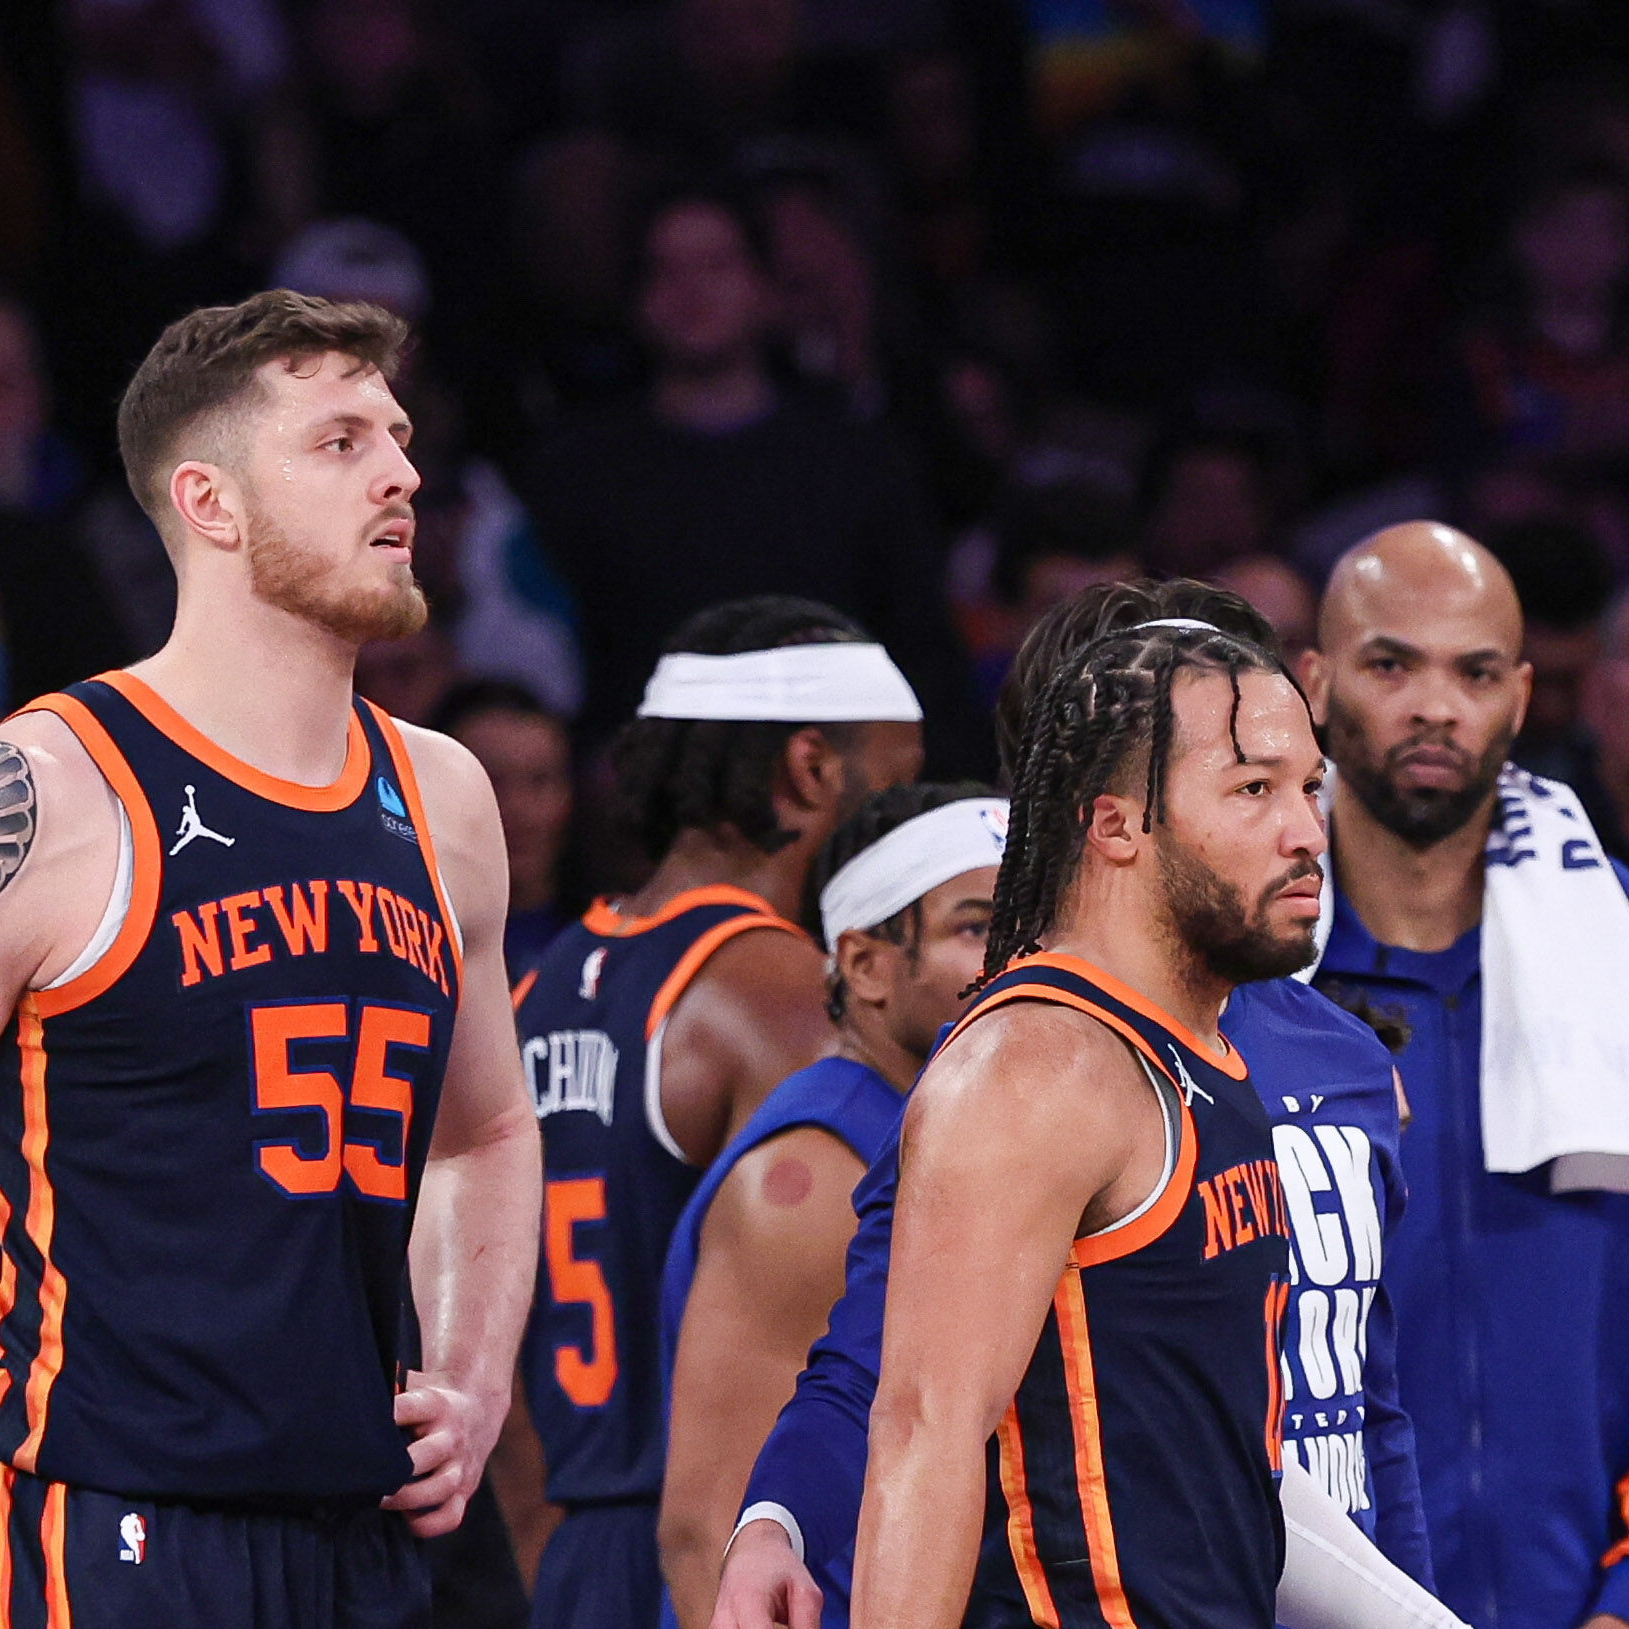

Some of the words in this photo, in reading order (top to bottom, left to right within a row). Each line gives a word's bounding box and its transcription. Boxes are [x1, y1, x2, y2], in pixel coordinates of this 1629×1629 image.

[172, 879, 328, 987] NEW
[337, 880, 449, 998] YORK
[245, 997, 437, 1207] 55
[1197, 1159, 1271, 1260] NEW
[1271, 1123, 1383, 1287] CK
